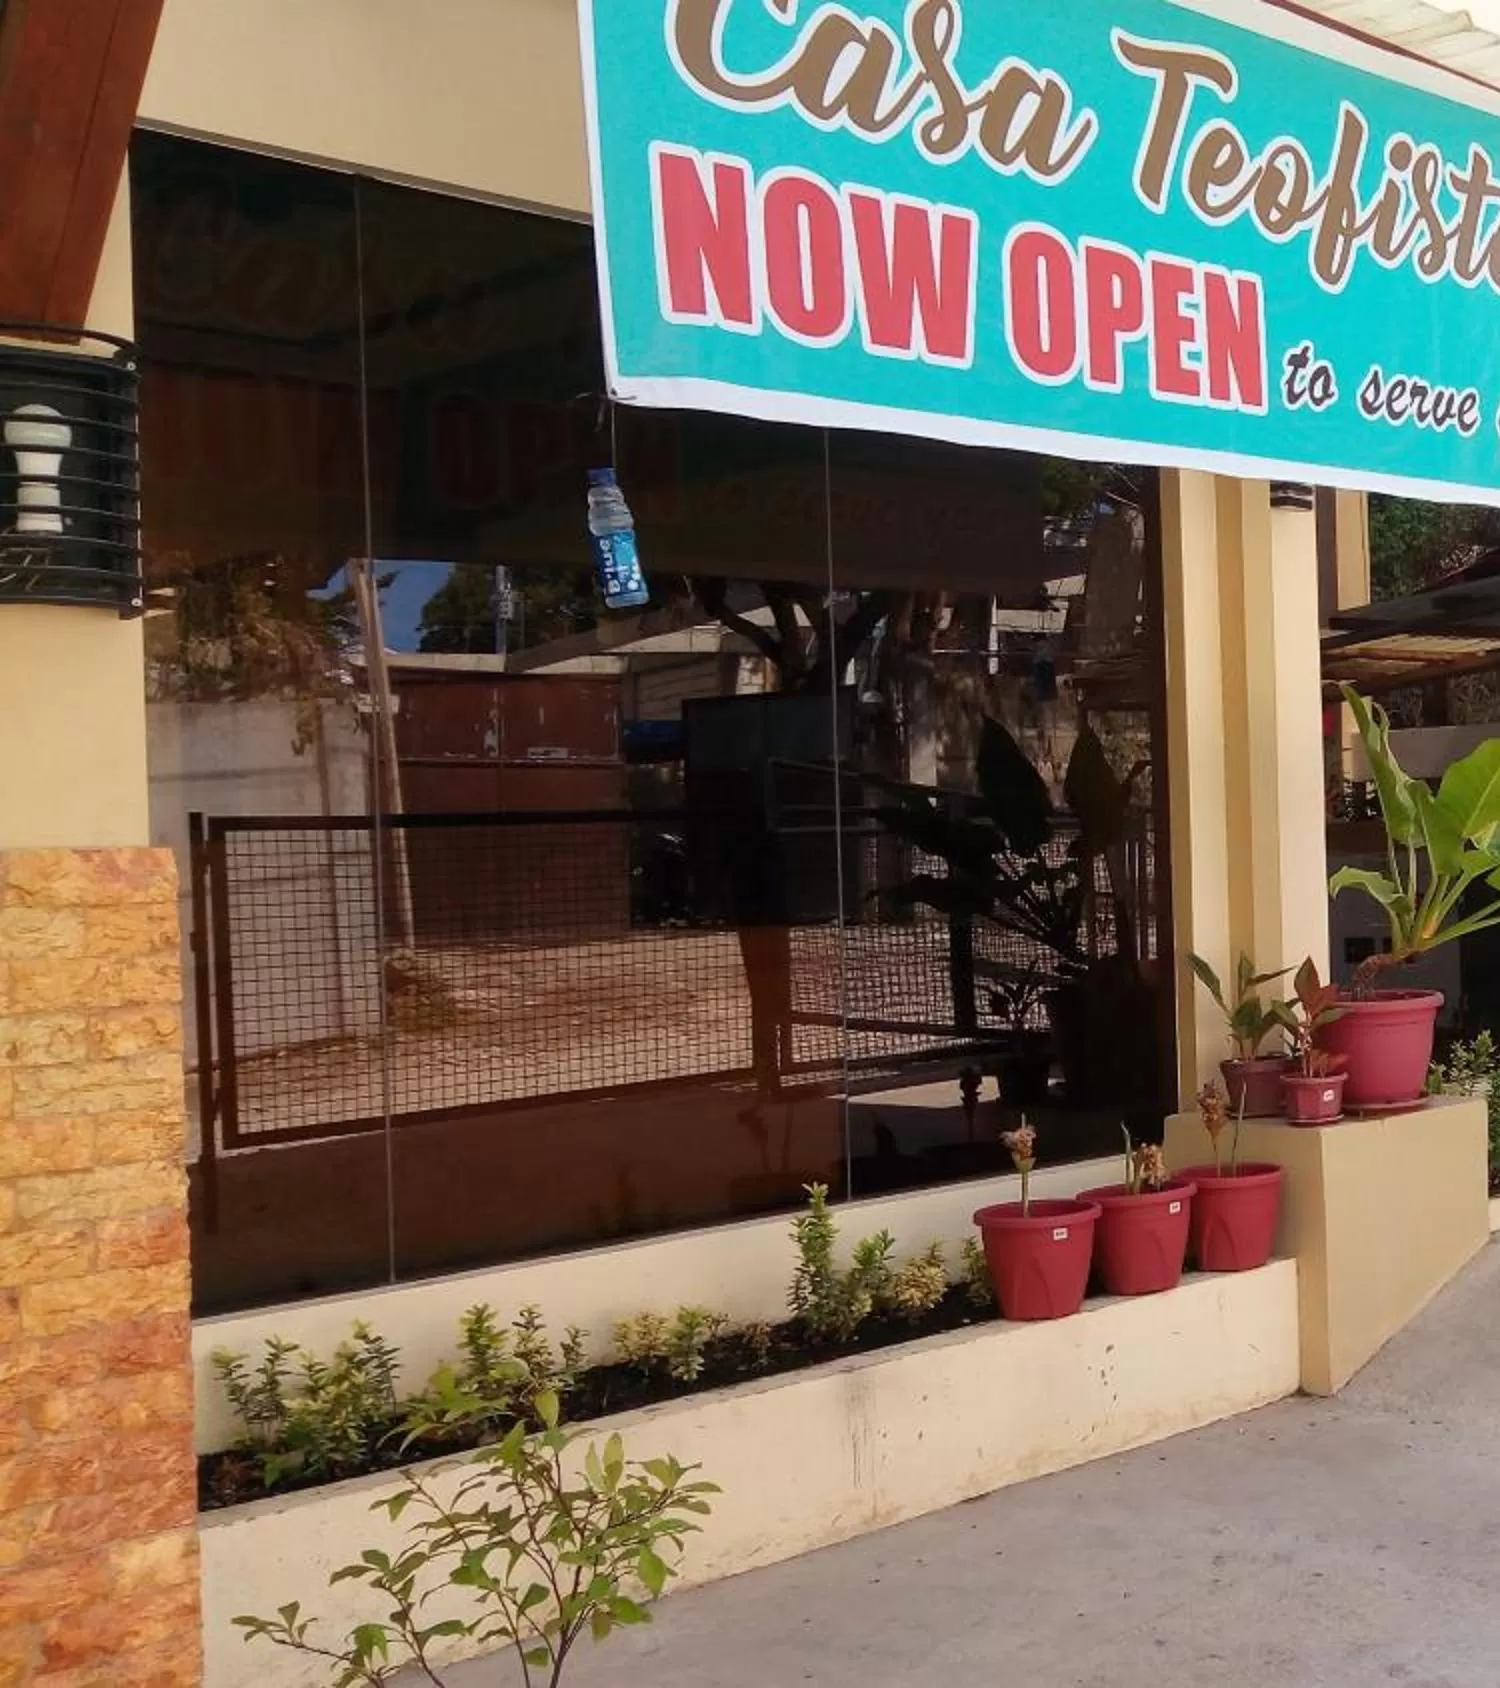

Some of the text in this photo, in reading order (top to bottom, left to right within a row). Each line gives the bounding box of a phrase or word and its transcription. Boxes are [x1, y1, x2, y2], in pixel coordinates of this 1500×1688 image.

[672, 0, 1094, 178] Casa
[658, 150, 1266, 408] NOW OPEN
[1284, 345, 1335, 407] to
[1360, 369, 1479, 433] serve
